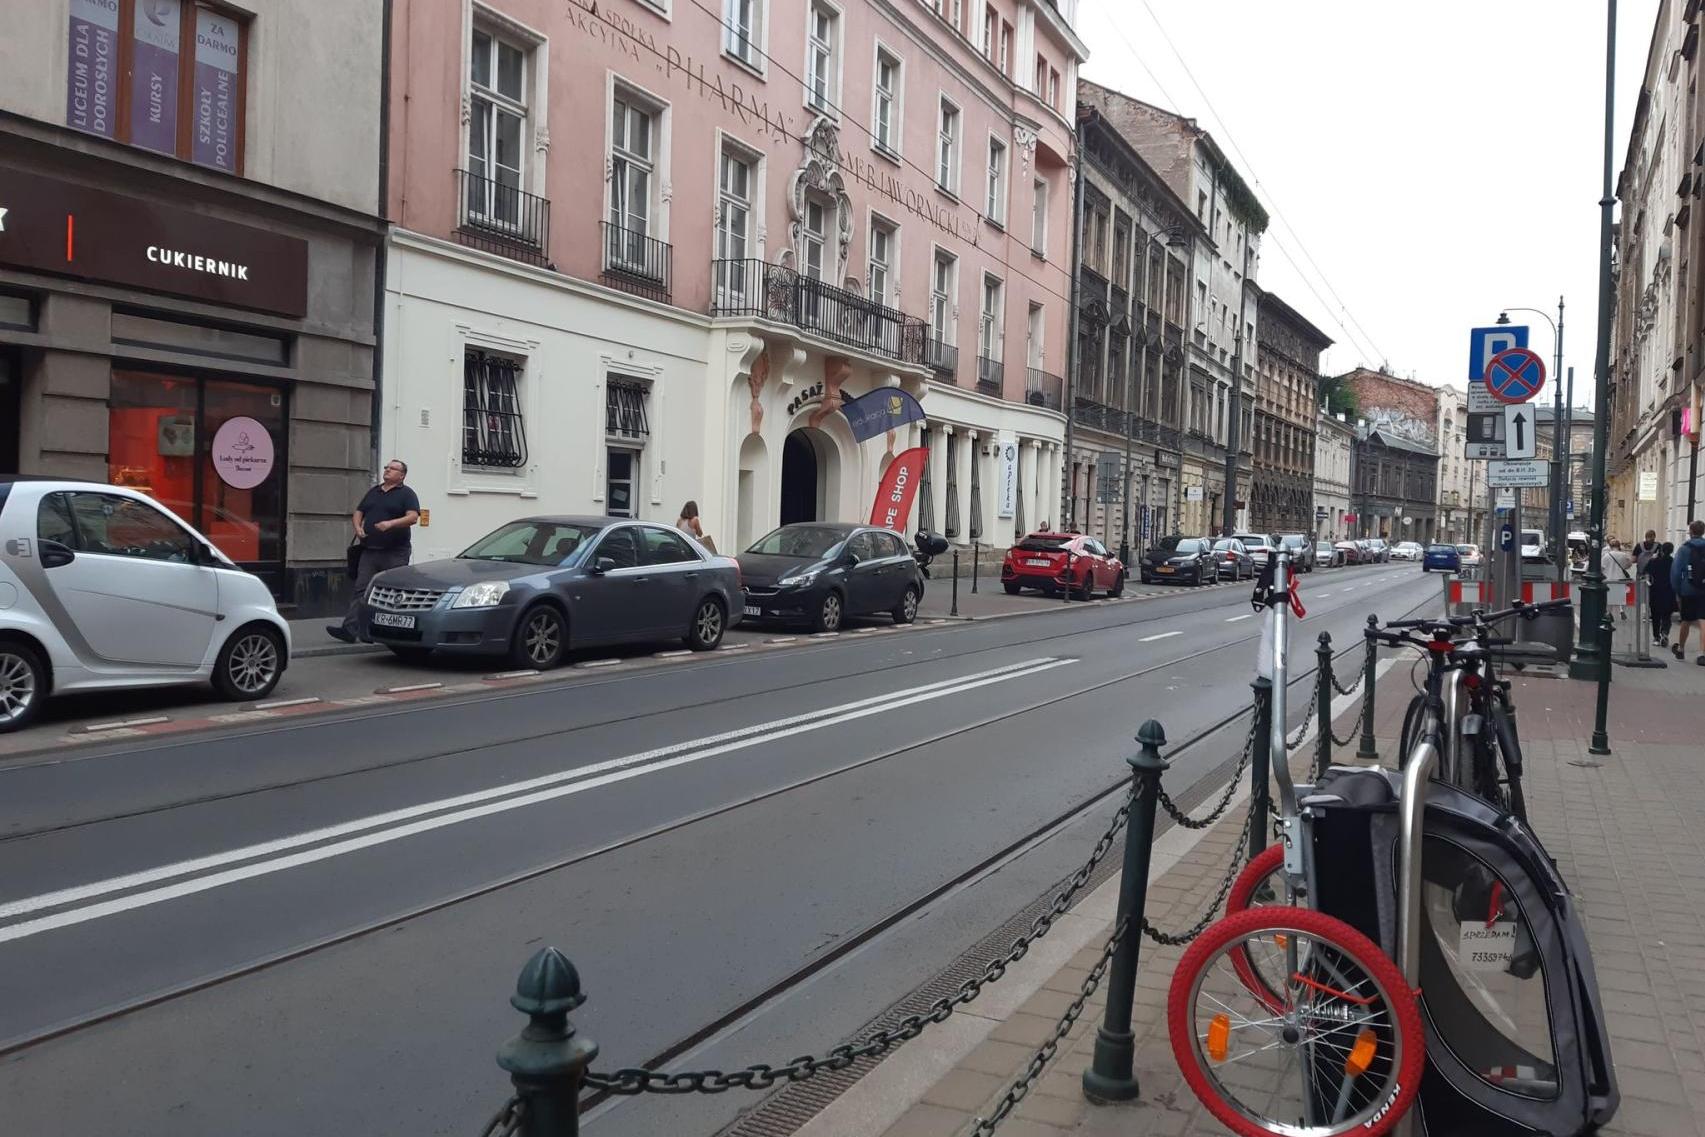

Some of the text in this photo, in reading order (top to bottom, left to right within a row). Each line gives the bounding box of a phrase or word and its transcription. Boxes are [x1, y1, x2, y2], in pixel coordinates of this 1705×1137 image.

[197, 36, 237, 57] DARMO
[210, 22, 225, 37] ZA
[73, 24, 90, 127] LICEUM DLA
[149, 72, 163, 124] KURSY
[215, 71, 230, 167] POLICEALNE
[146, 245, 249, 281] CUKIERNIK
[891, 466, 909, 503] SHOP
[1363, 1083, 1401, 1129] KENDA
